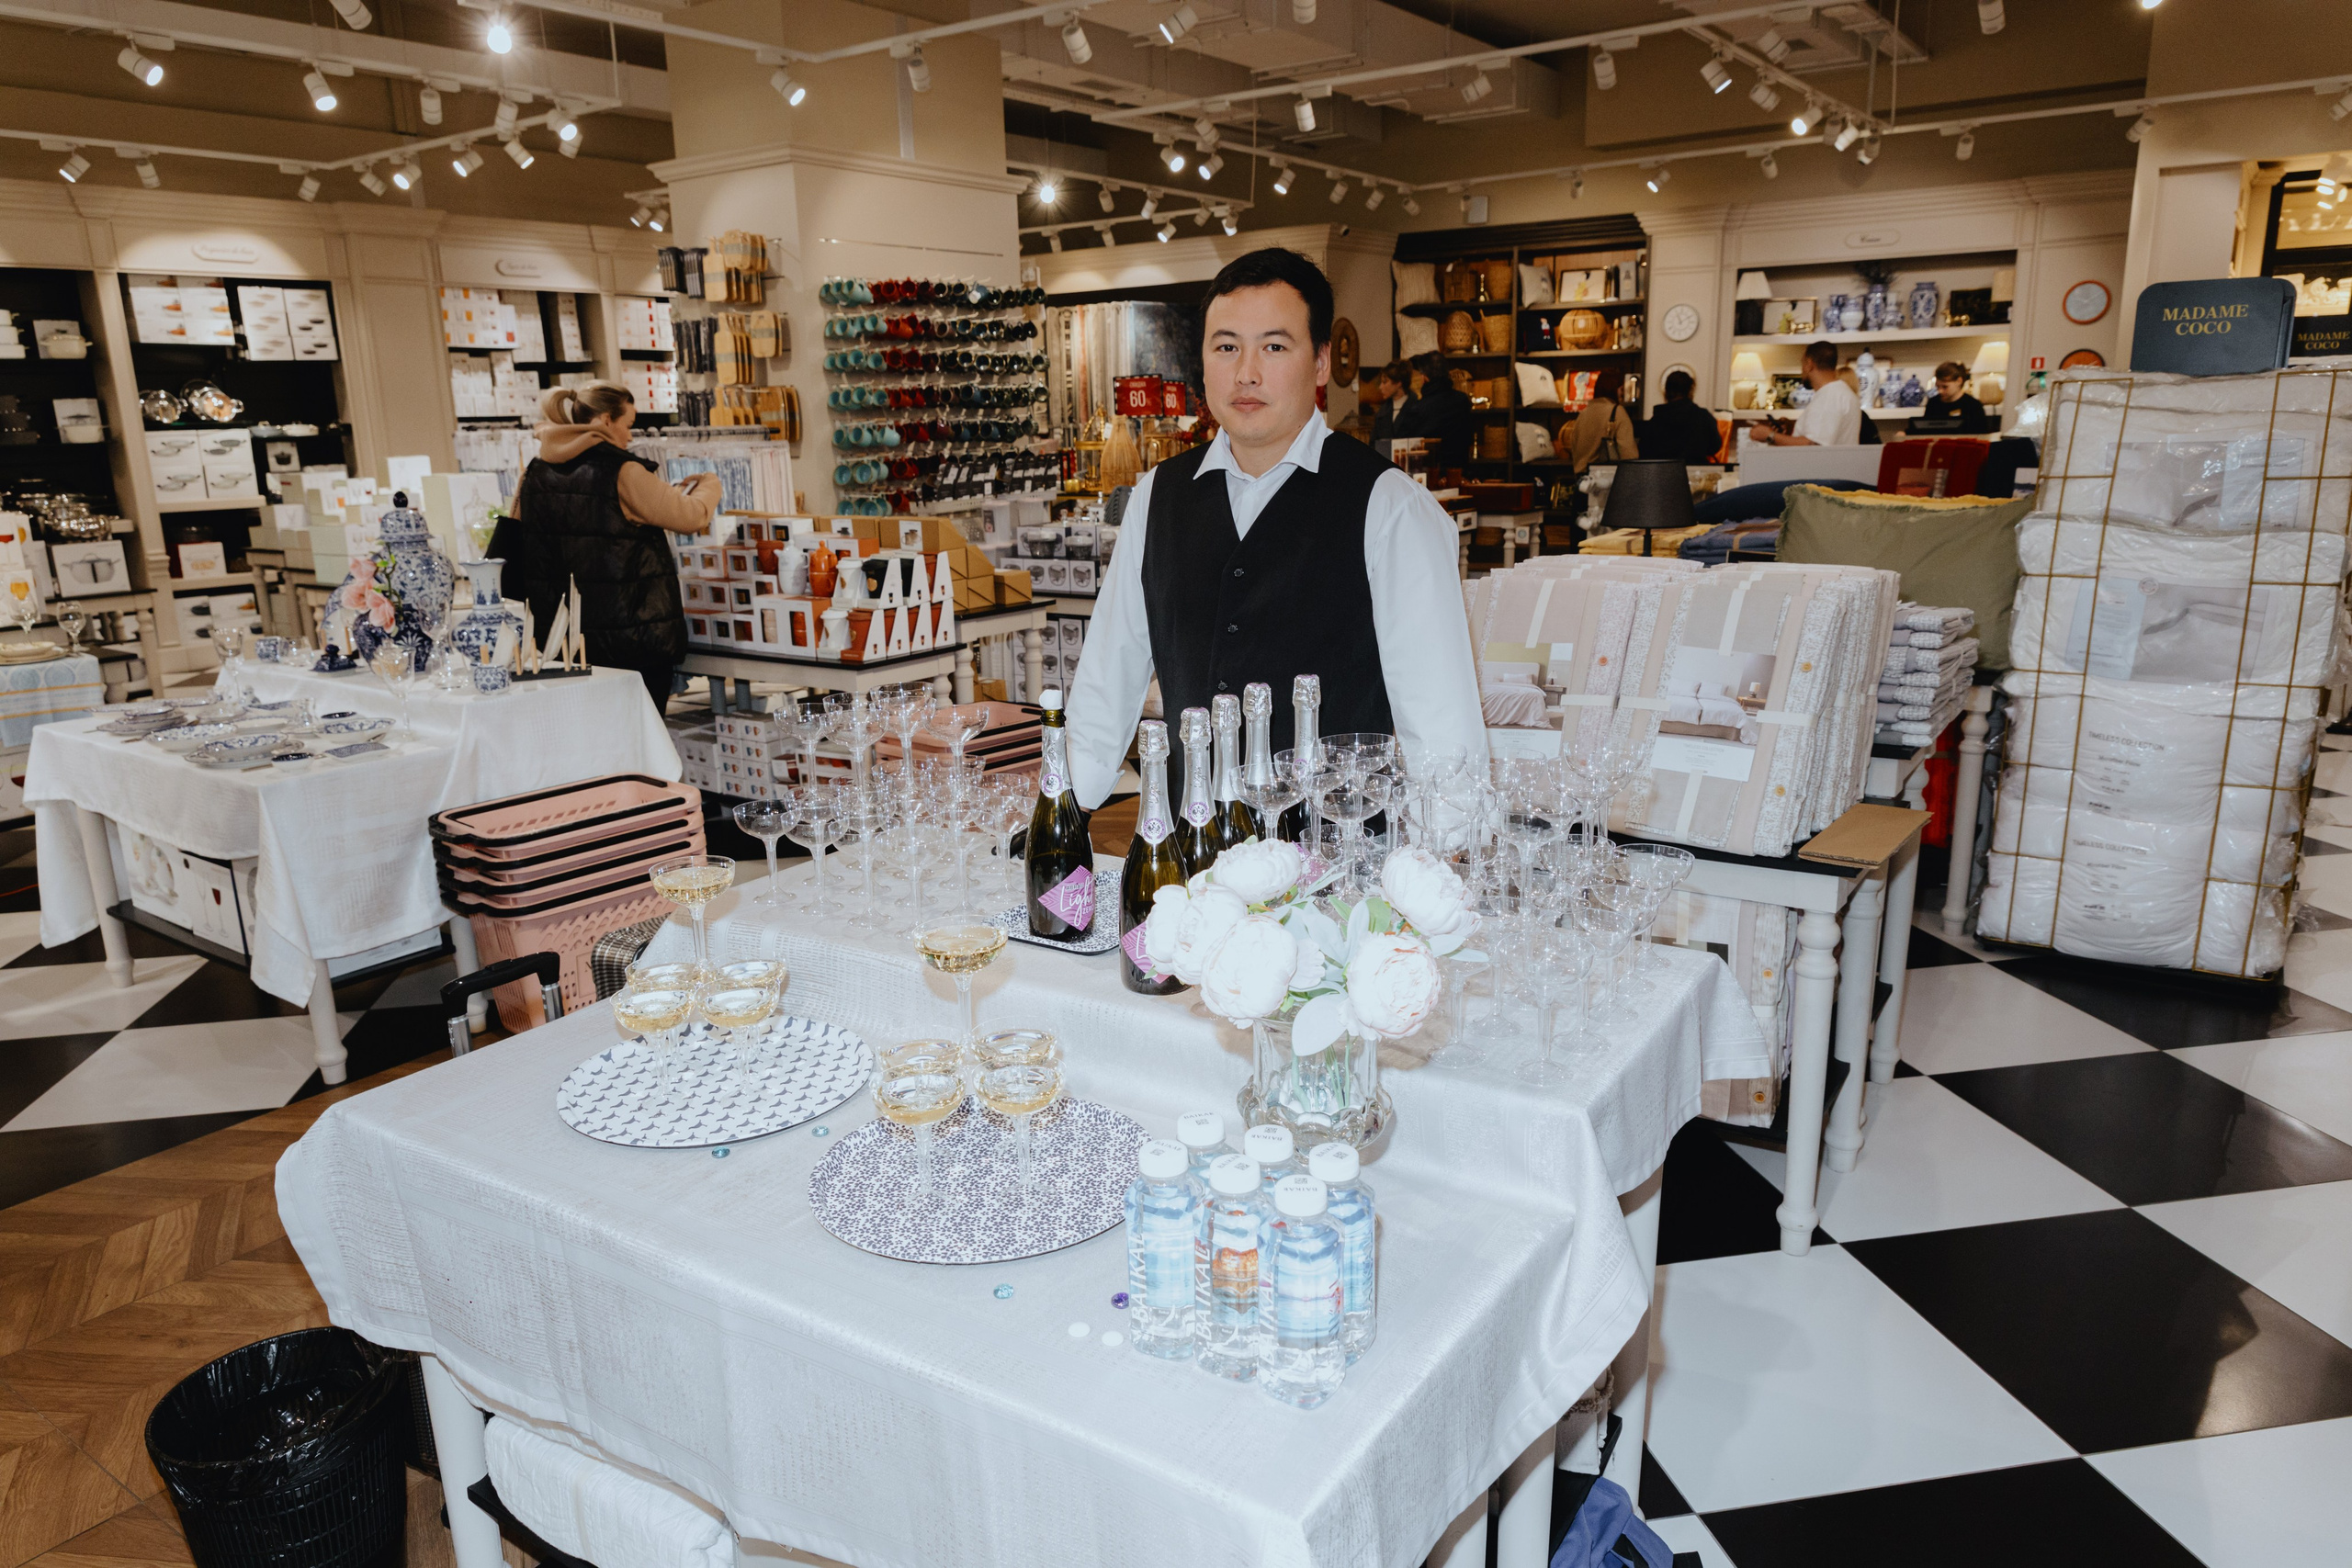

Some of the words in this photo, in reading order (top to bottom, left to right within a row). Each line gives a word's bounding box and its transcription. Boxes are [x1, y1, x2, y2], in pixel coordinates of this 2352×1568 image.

[2162, 304, 2249, 321] MADAME
[2175, 321, 2232, 336] COCO
[2297, 331, 2350, 341] MADAME
[2305, 341, 2340, 351] COCO
[1129, 389, 1147, 408] 60
[1165, 393, 1177, 409] 60
[2088, 731, 2120, 743] TIMELESS
[2120, 738, 2165, 750] COLLECTION
